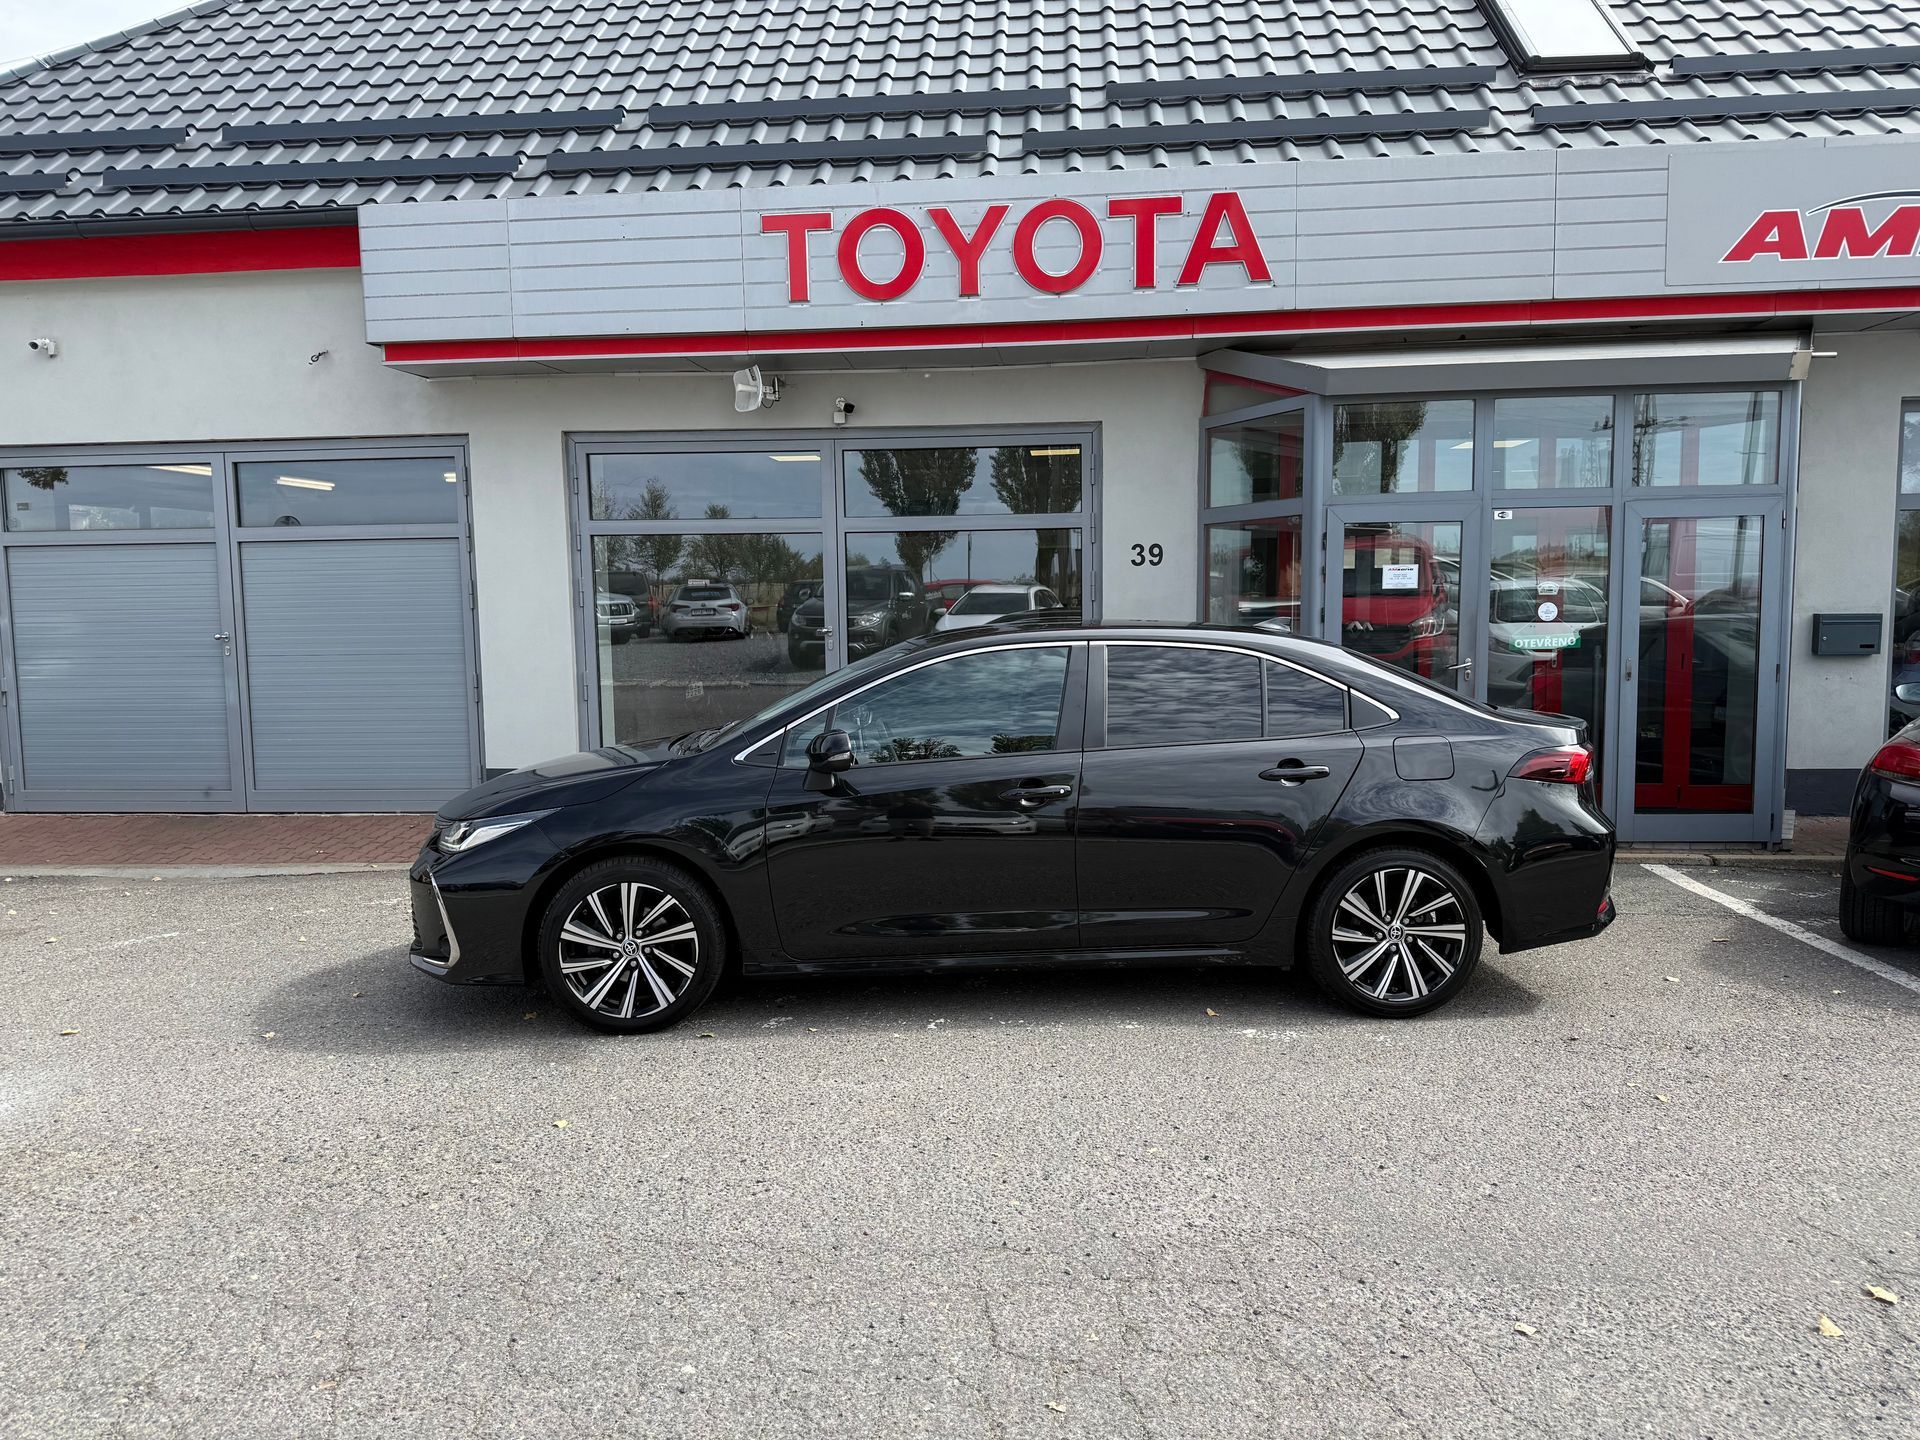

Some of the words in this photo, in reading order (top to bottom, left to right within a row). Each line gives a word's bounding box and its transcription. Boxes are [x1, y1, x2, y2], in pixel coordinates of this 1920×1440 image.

[760, 191, 1273, 303] TOYOTA
[1718, 204, 1920, 263] AM
[1131, 543, 1164, 567] 39
[1514, 635, 1576, 648] OTEVŘENO
